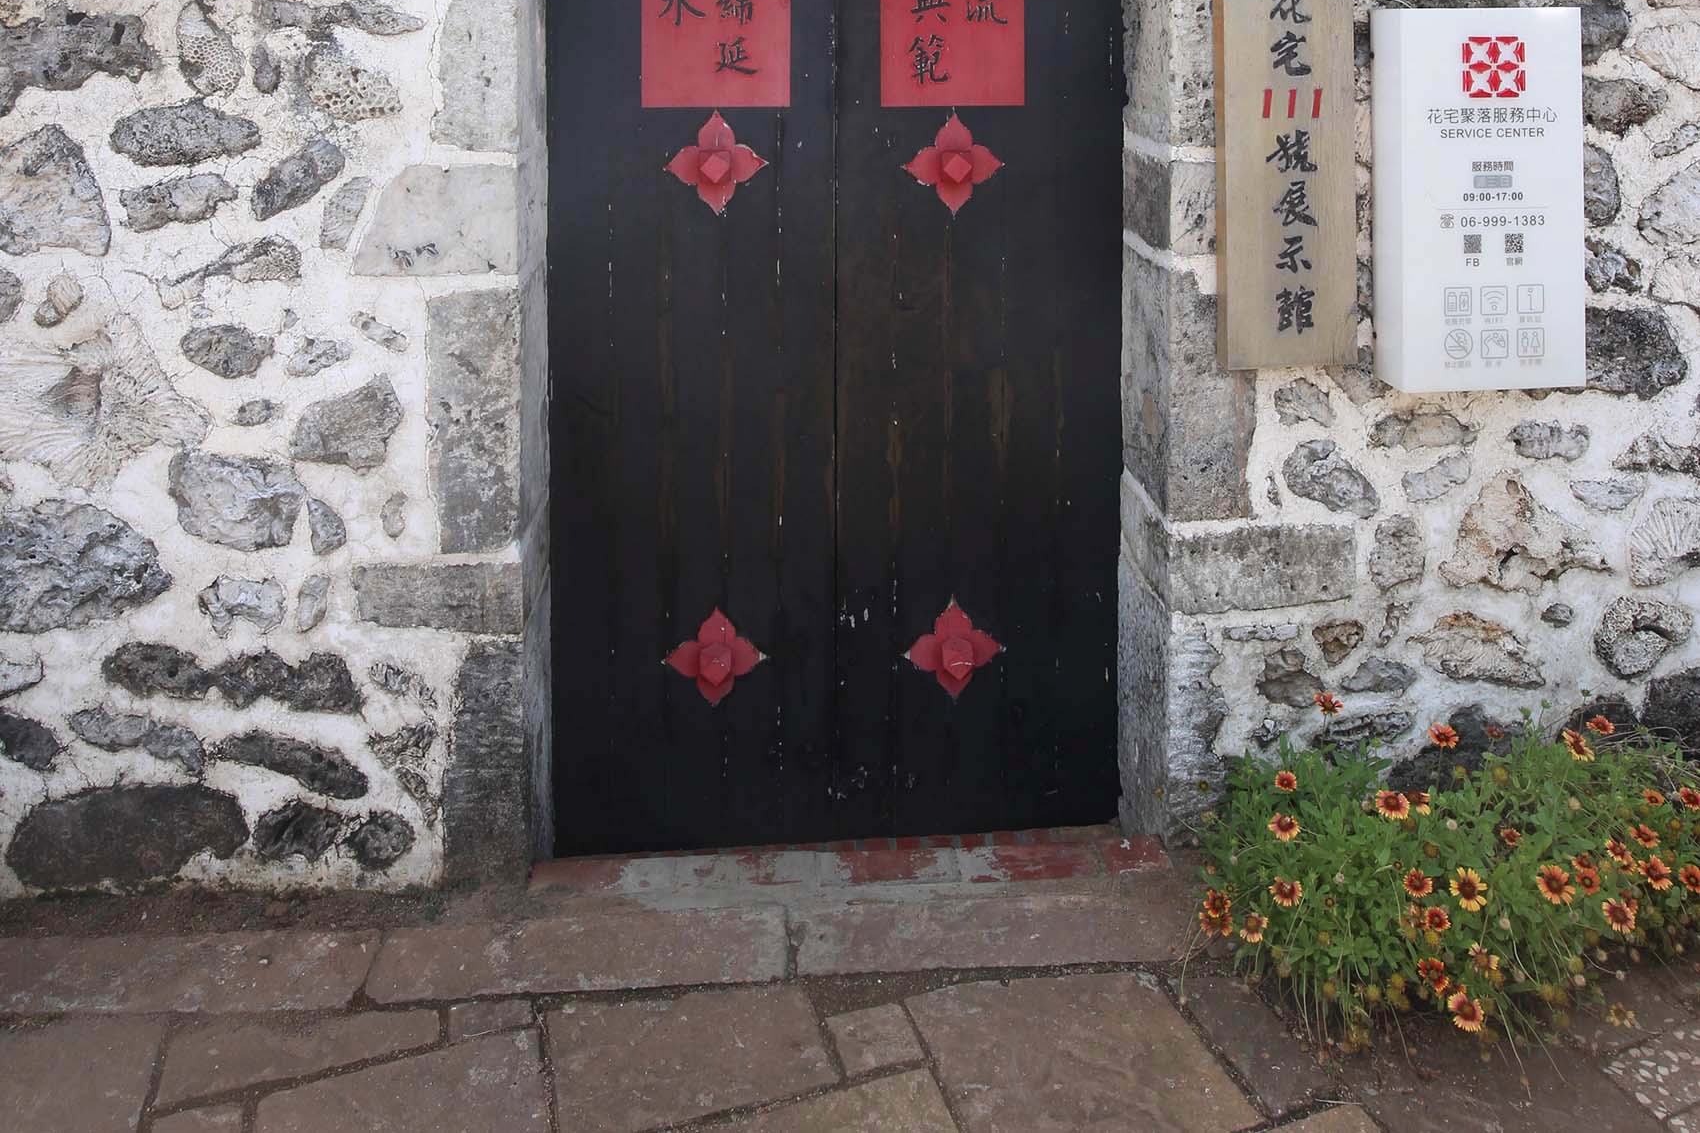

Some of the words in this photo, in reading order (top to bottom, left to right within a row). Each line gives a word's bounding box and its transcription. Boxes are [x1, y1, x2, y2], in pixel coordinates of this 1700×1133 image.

[1427, 107, 1557, 124] 花宅聚落服務中心
[1440, 128, 1492, 138] SERVICE
[1496, 127, 1545, 138] CENTER
[1472, 161, 1514, 172] 服務時間
[1463, 192, 1524, 202] 09:00-17:00
[1460, 216, 1545, 227] 06-999-1383
[1465, 258, 1480, 267] FB
